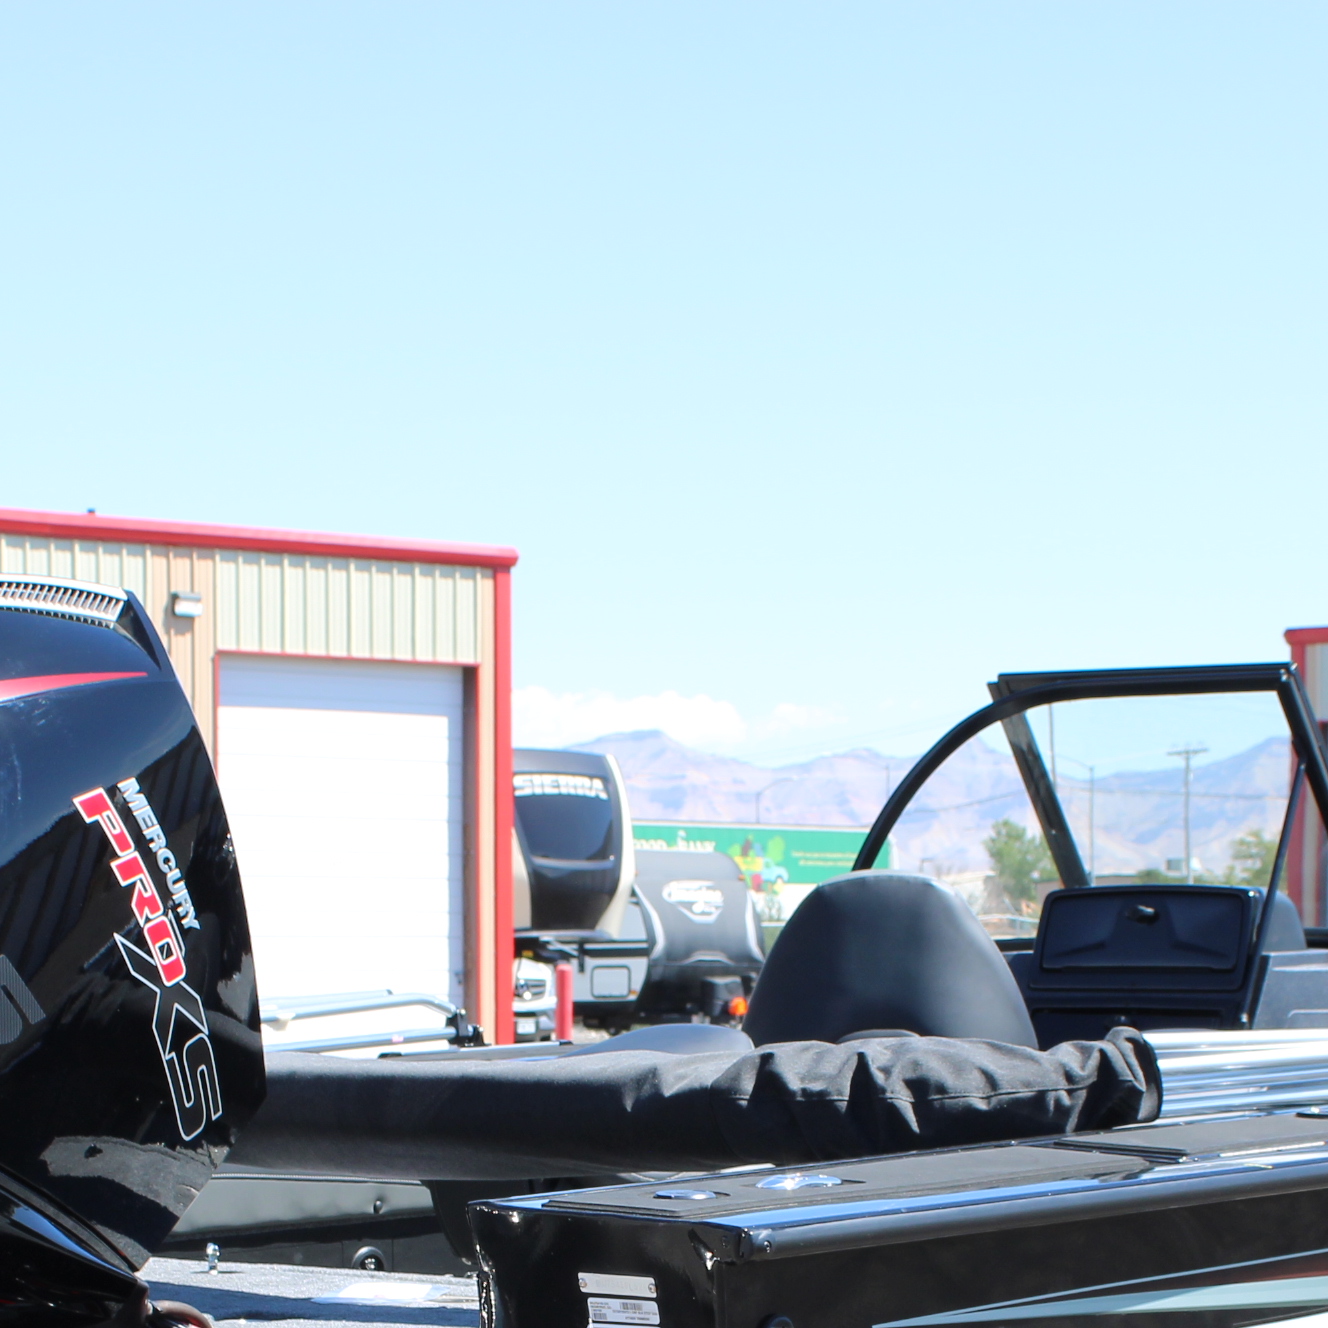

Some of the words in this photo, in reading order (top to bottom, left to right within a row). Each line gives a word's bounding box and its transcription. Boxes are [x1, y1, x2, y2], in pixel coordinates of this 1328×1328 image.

[118, 777, 200, 930] MERCURY
[513, 772, 609, 800] SIERRA
[73, 787, 186, 986] PRO
[114, 908, 222, 1141] XS
